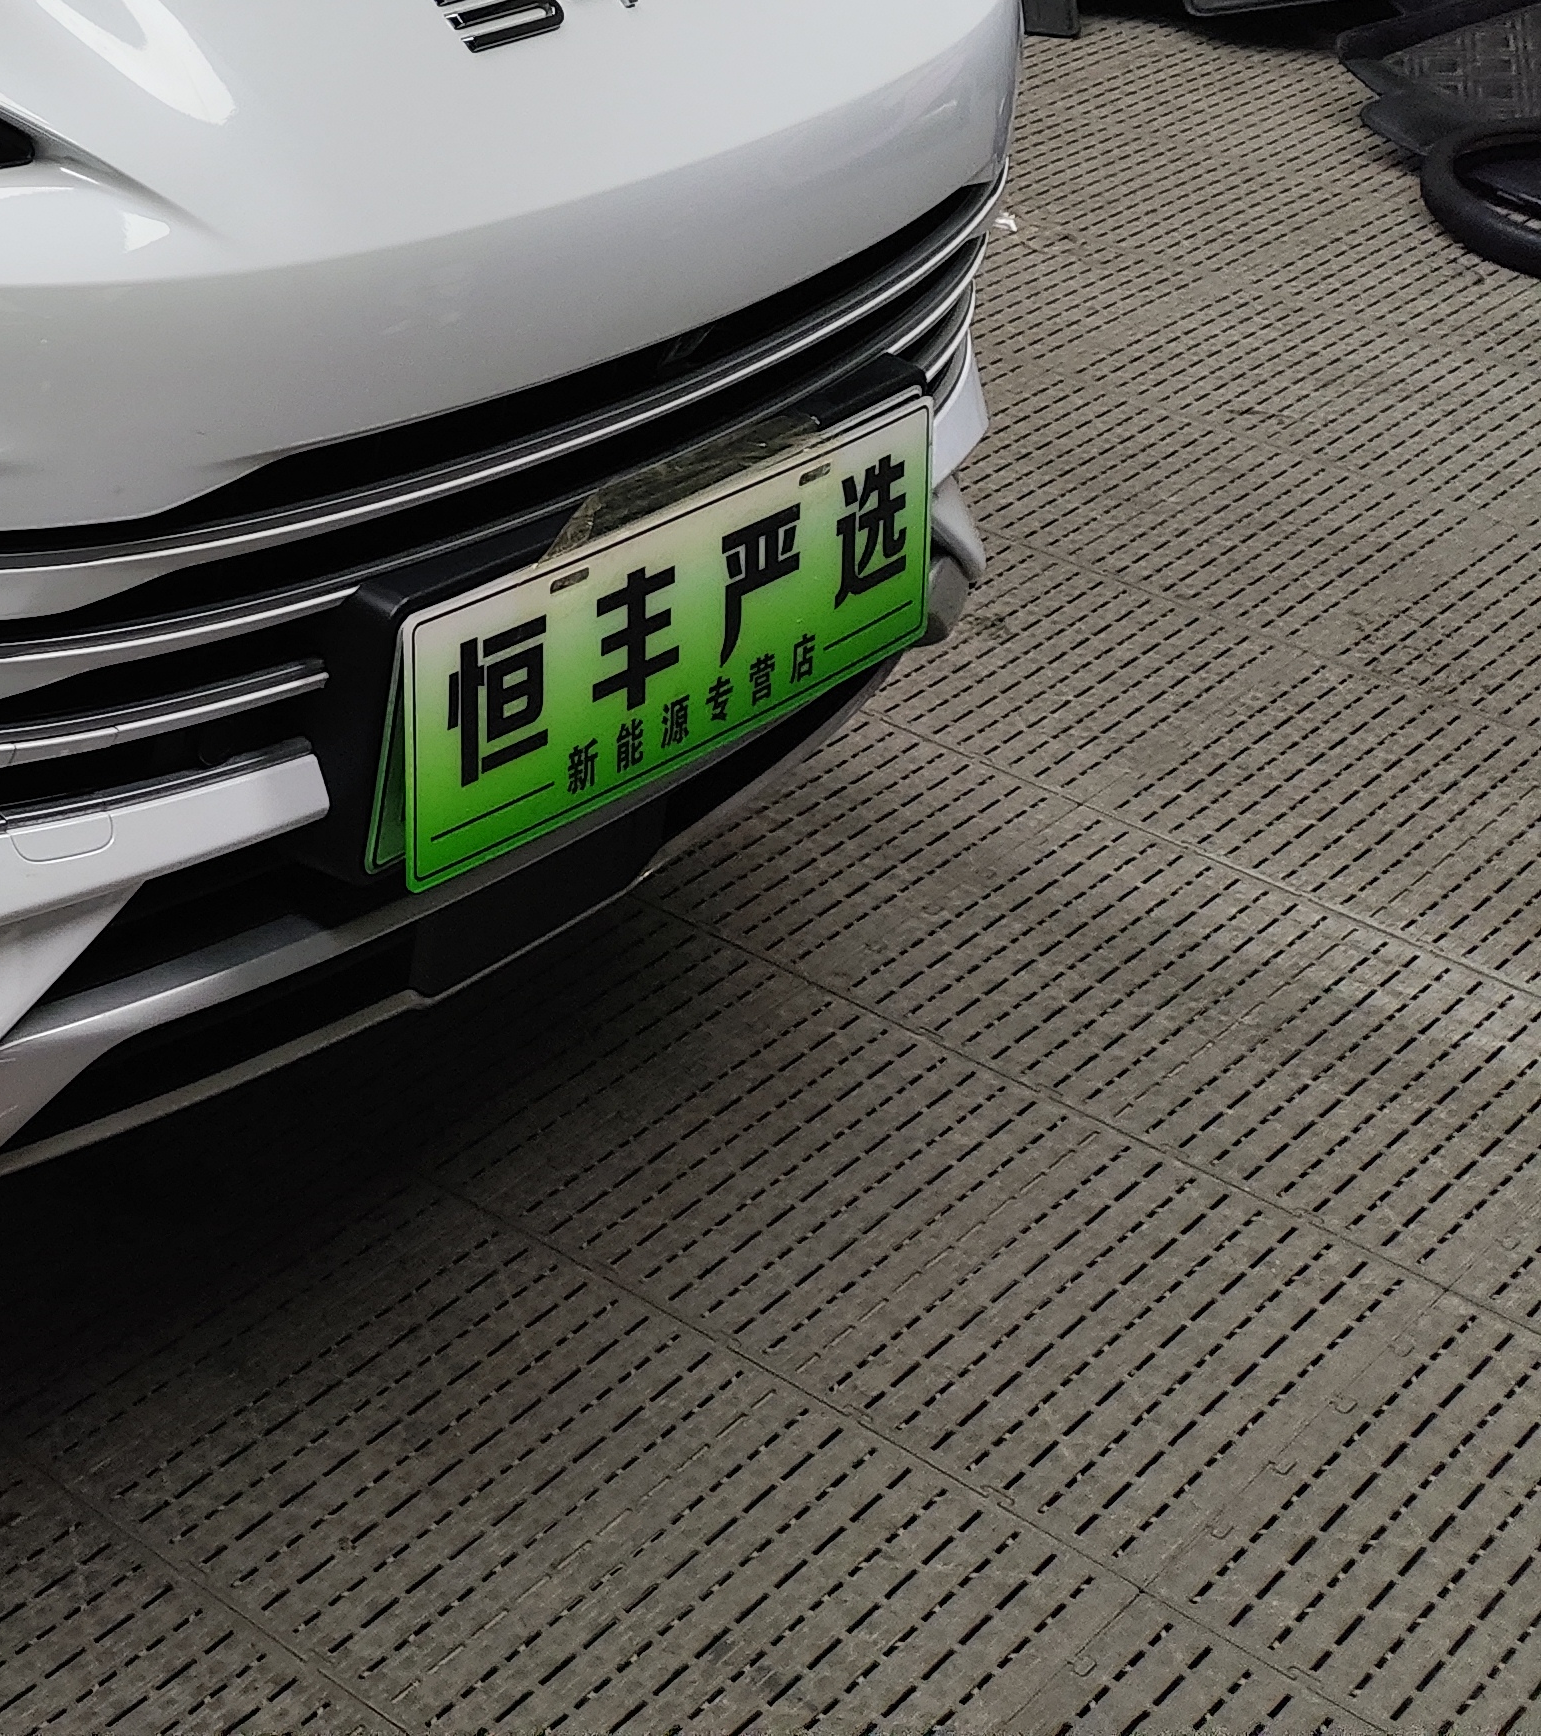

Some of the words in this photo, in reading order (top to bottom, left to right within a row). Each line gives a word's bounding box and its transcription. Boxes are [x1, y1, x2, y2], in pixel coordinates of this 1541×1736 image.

[446, 453, 907, 789] 恒丰严选
[566, 634, 817, 795] 新能源专营店
